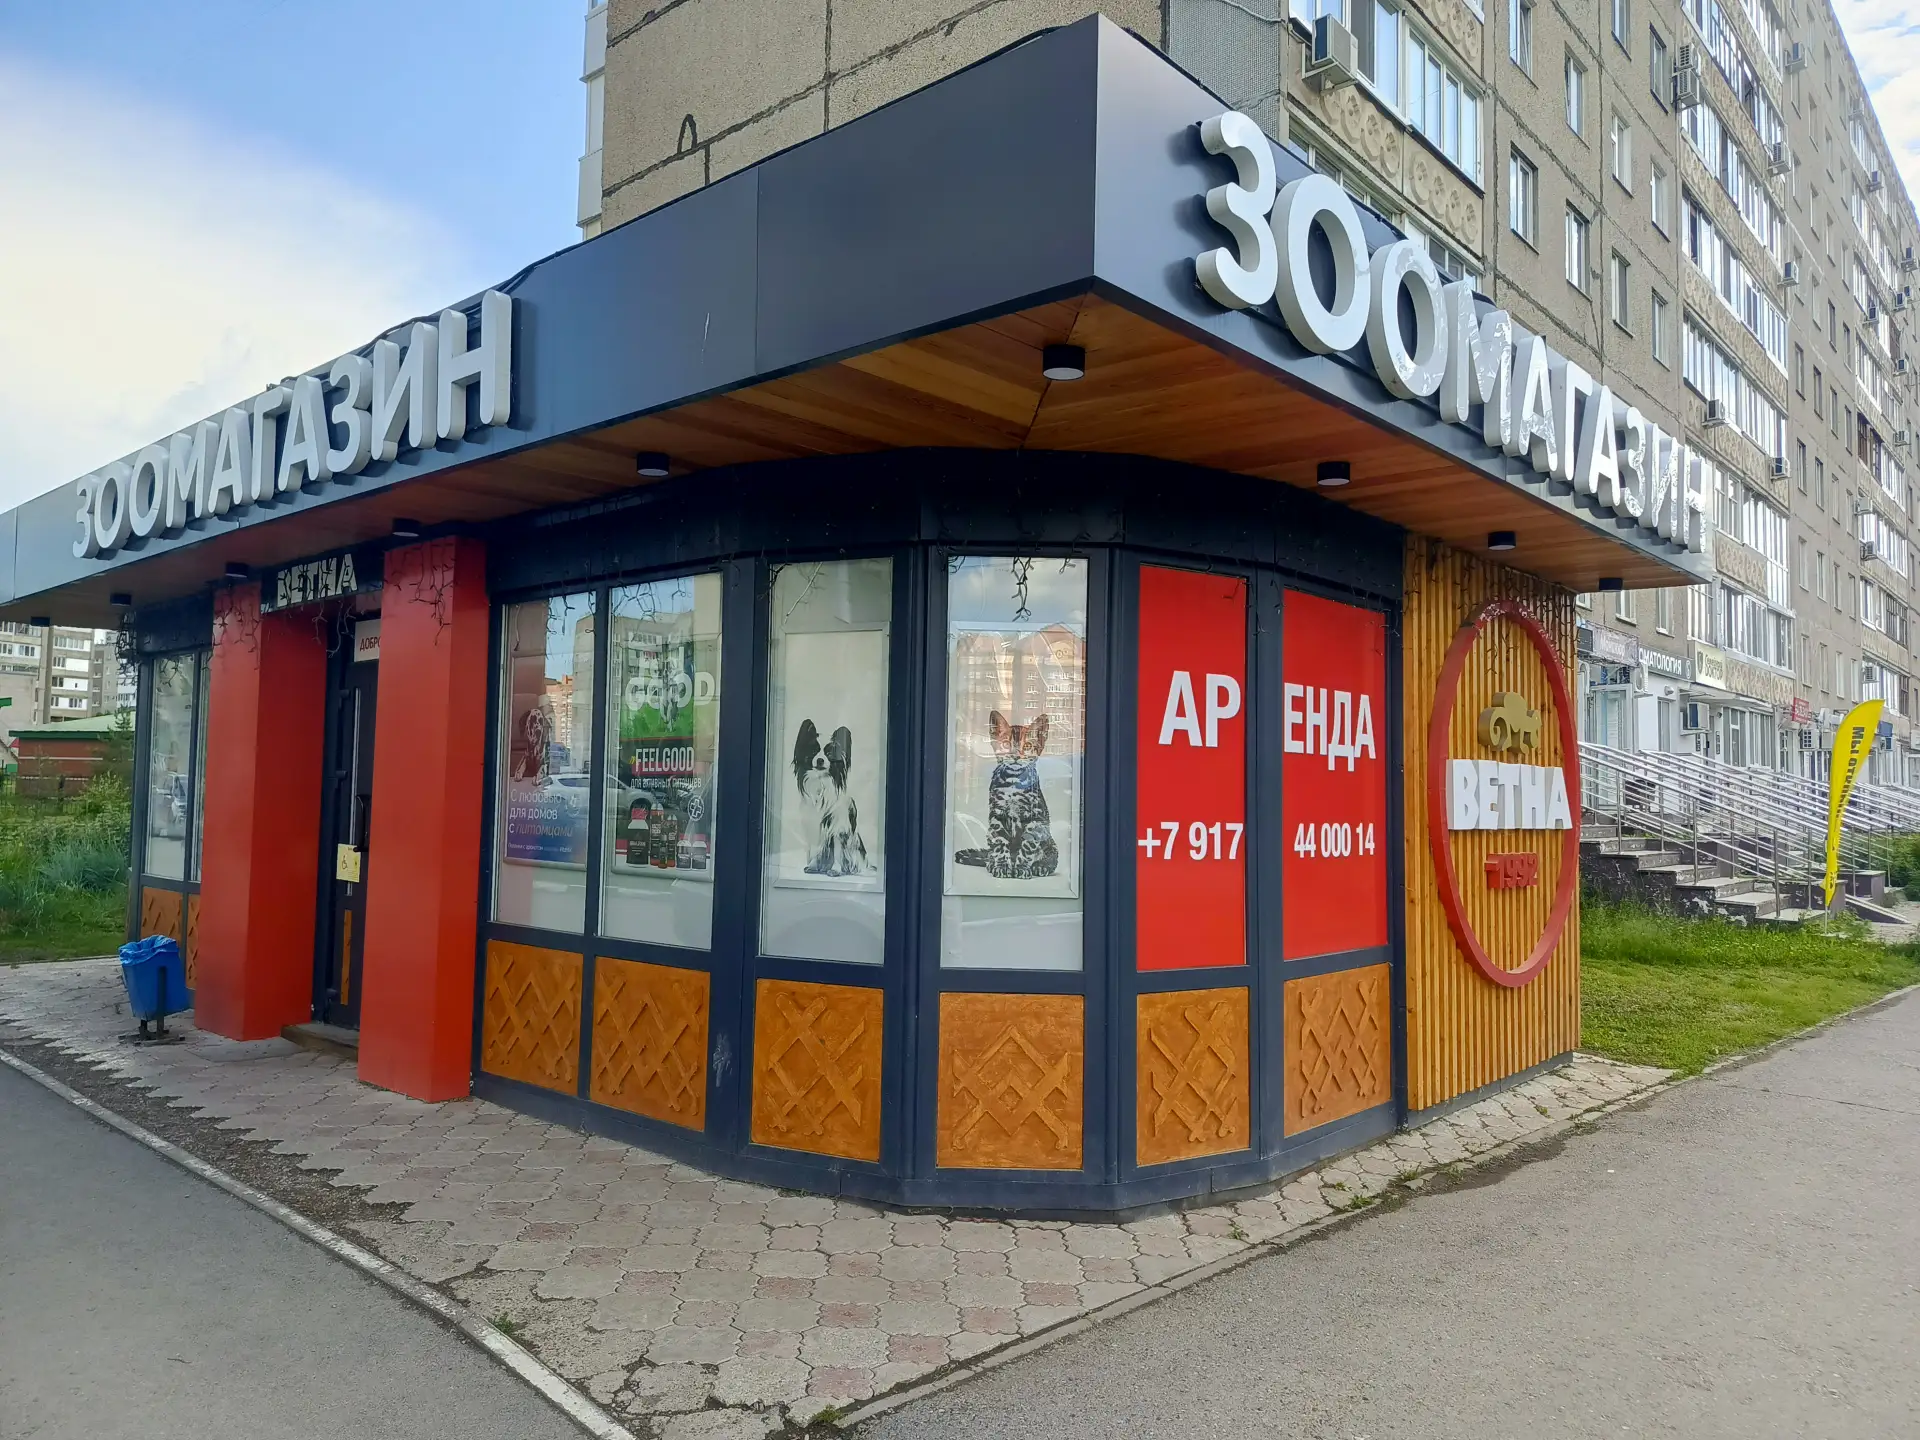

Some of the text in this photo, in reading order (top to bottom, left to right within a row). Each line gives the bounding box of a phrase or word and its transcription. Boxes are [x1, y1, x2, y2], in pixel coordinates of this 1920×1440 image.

[1196, 110, 1707, 554] ЗООМАГАЗИН
[72, 289, 512, 559] ЗООМАГАЗИН
[635, 747, 695, 772] FEELGOOD
[509, 808, 558, 820] для домов
[1446, 759, 1573, 830] ВЕТНА
[1137, 821, 1376, 861] +7 917 44 000 14
[1487, 852, 1538, 889] 1992
